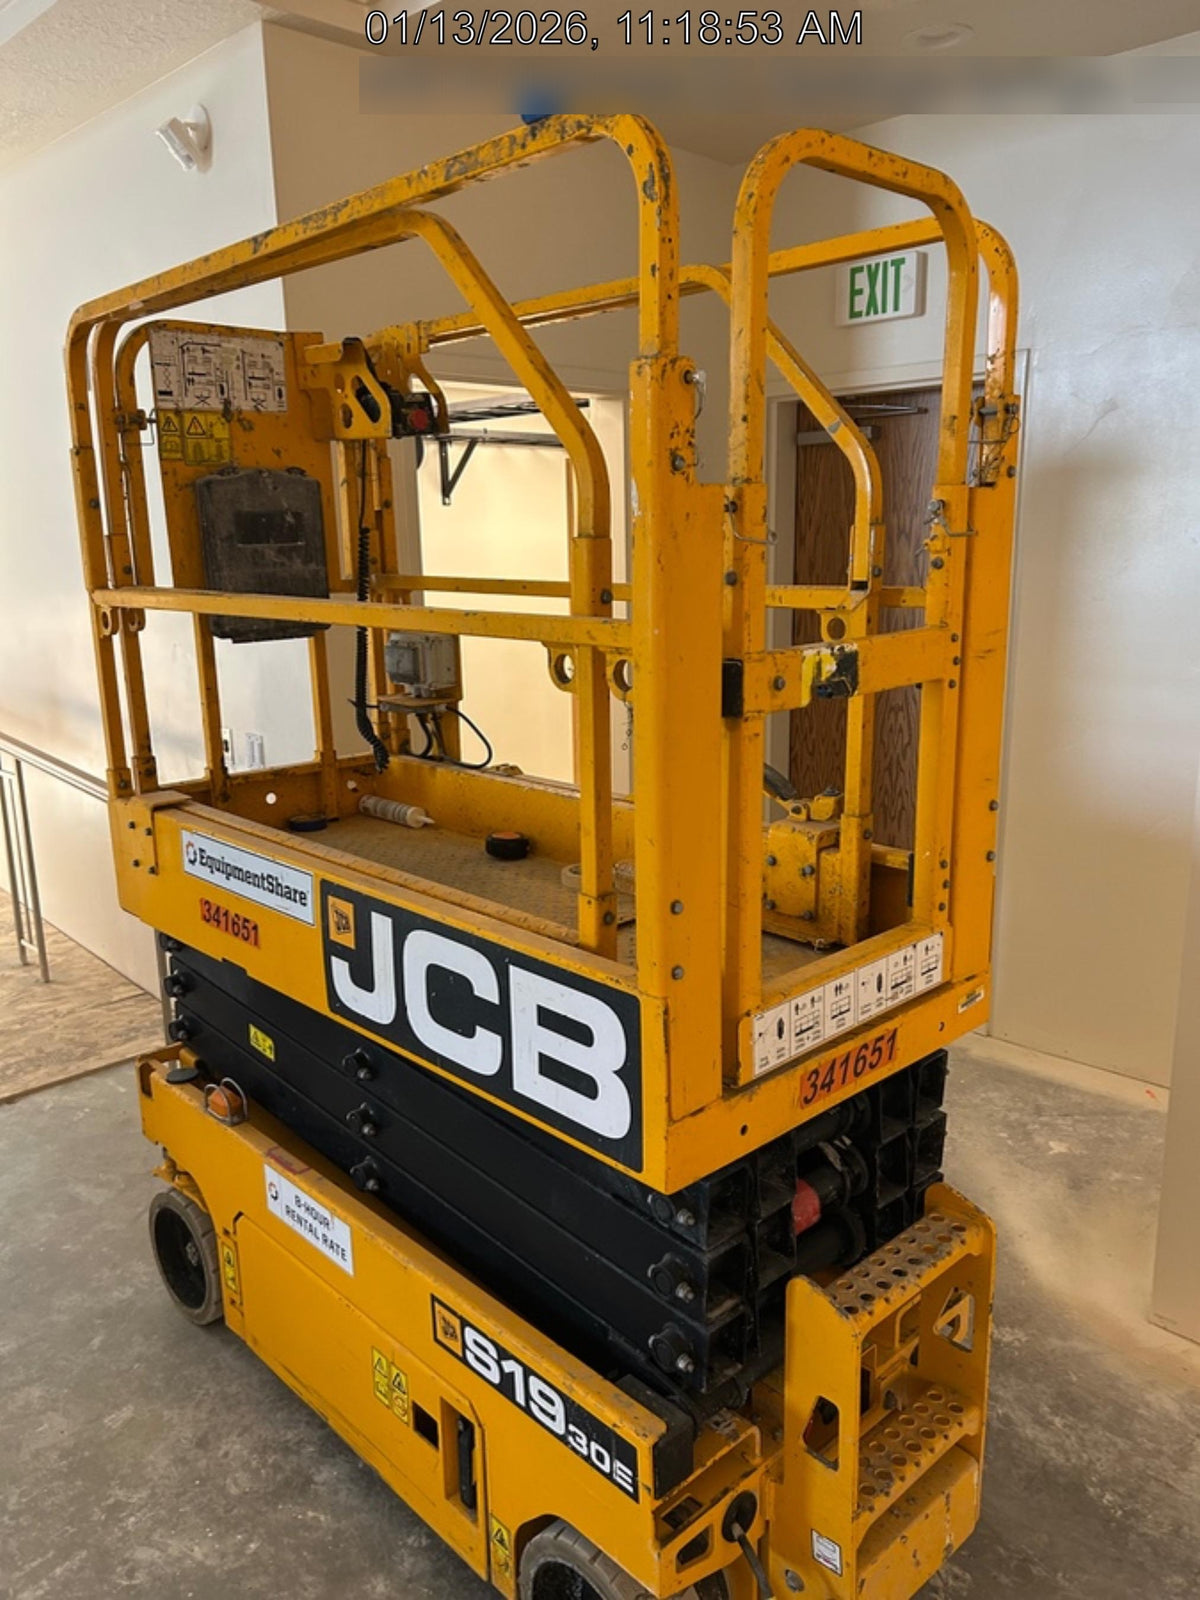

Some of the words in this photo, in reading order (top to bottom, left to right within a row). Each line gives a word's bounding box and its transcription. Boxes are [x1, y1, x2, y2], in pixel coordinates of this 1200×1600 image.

[849, 256, 906, 319] EXIT
[198, 847, 308, 907] EquipmentShare
[203, 900, 260, 947] 341651
[330, 911, 632, 1140] JCB
[803, 1027, 898, 1104] 341651
[285, 1204, 320, 1241] RENTAL
[321, 1233, 348, 1262] RATE
